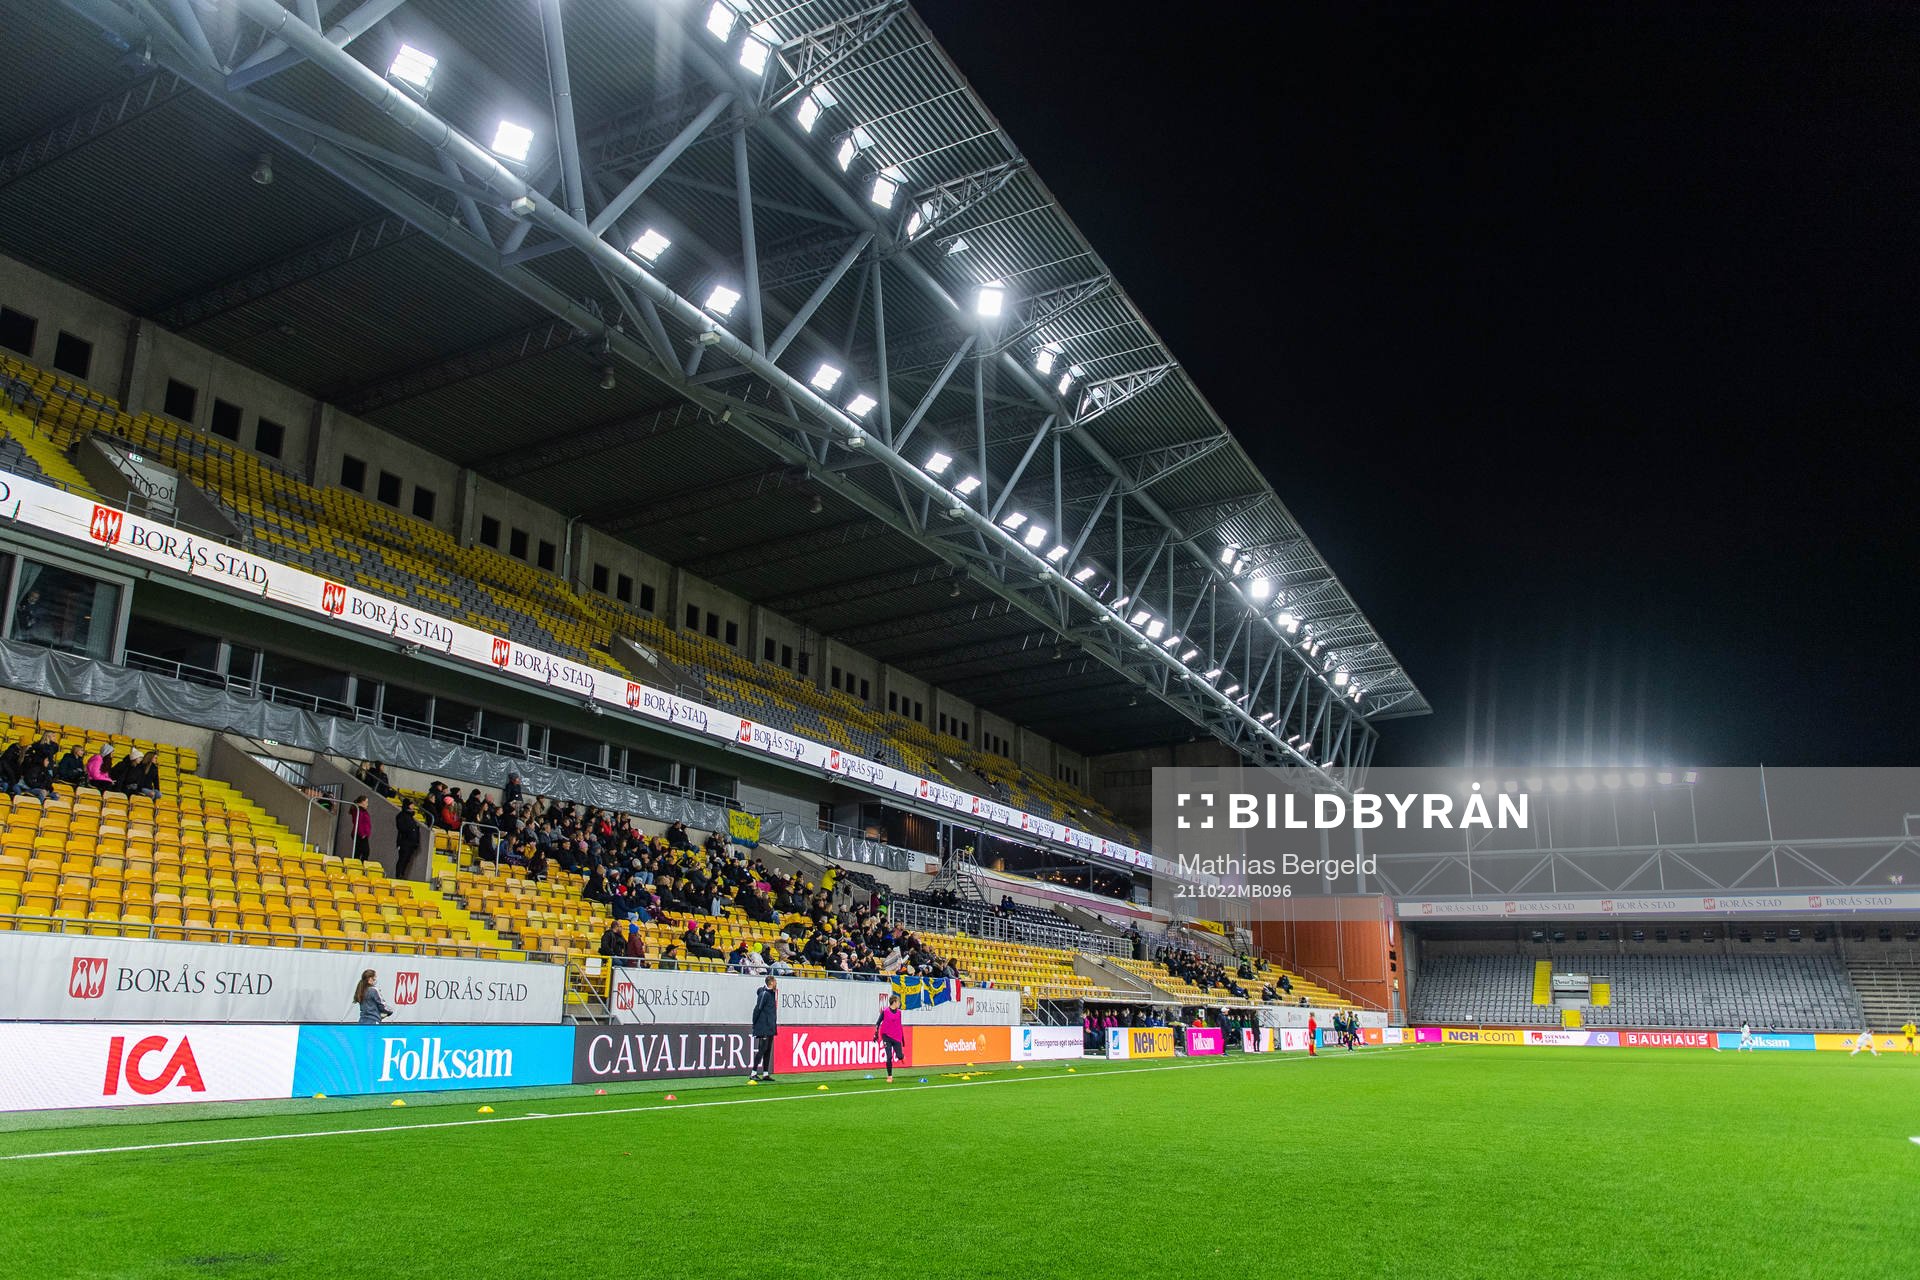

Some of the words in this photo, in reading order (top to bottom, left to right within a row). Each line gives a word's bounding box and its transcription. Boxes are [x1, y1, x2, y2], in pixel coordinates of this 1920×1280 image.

[130, 524, 208, 567] BORÅS
[213, 552, 268, 584] STAD
[352, 597, 409, 630] BORÅS
[414, 617, 453, 644] STAD
[515, 651, 559, 678] BORÅS
[561, 666, 594, 689] STAD
[644, 692, 679, 718] BORÅS
[681, 705, 708, 724] STAD
[754, 728, 782, 748] BORÅS
[784, 738, 805, 756] STAD
[1436, 903, 1465, 912] BORÅS
[1466, 904, 1489, 912] STAD
[1519, 902, 1550, 912] BORÅS
[1552, 903, 1575, 911] STAD
[1617, 899, 1649, 910] BORÅS
[1651, 901, 1676, 909] STAD
[1719, 897, 1754, 908] BORÅS
[1756, 899, 1782, 908] STAD
[1826, 895, 1862, 906] BORÅS
[1865, 897, 1892, 905] STAD
[116, 963, 206, 994] BORÅS
[213, 971, 273, 995] STAD
[424, 977, 483, 1001] BORÅS
[487, 981, 528, 1002] STAD
[637, 985, 679, 1006] BORÅS
[681, 989, 710, 1007] STAD
[781, 990, 813, 1008] BORÅS
[814, 993, 837, 1008] STAD
[792, 1033, 899, 1067] Kommuna
[943, 1038, 977, 1052] Swedbank
[1628, 1032, 1709, 1046] BAUHAUS
[103, 1034, 206, 1095] ICA
[377, 1037, 513, 1082] Folksam
